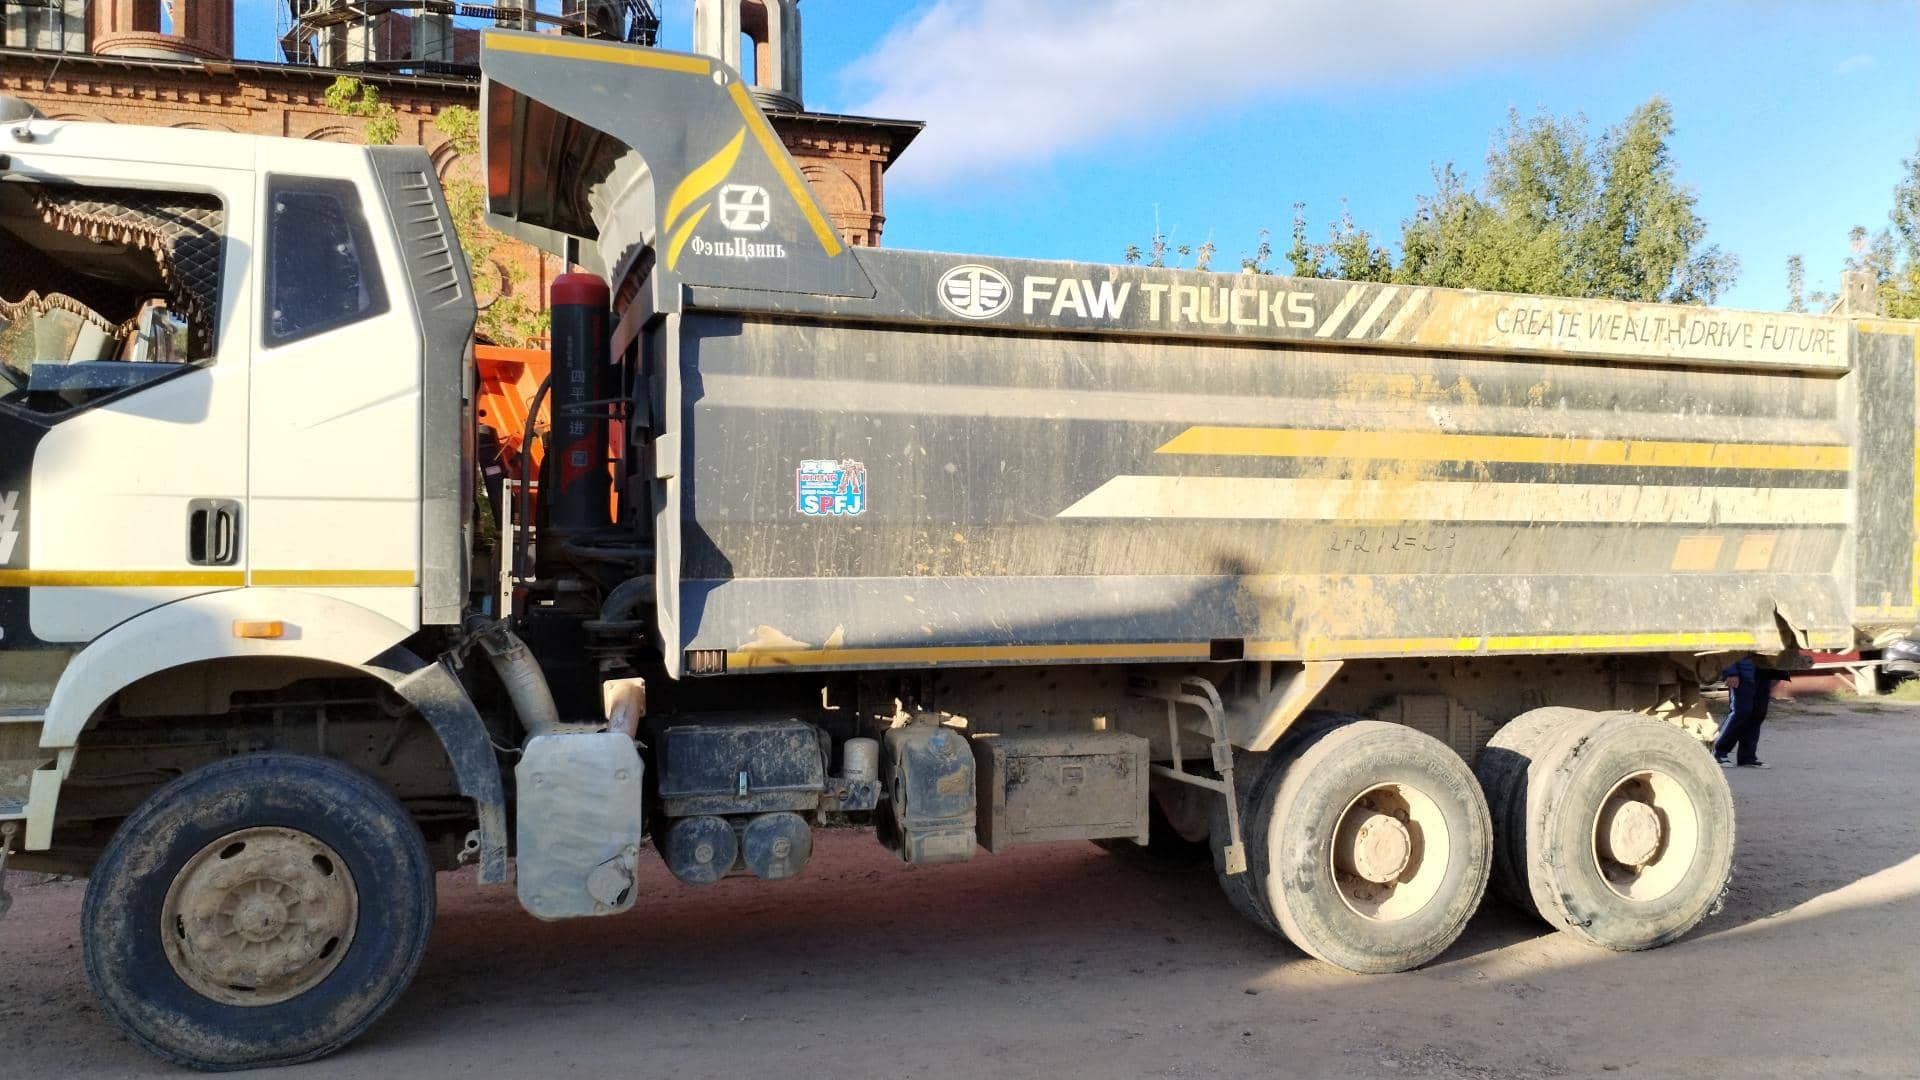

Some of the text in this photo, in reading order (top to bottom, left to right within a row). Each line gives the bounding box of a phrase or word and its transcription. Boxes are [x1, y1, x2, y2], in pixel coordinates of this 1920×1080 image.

[1023, 275, 1316, 328] FAW TRUCKS
[1494, 307, 1583, 338] CREATE
[1760, 324, 1837, 354] FUTURE
[804, 495, 861, 515] SPFJ
